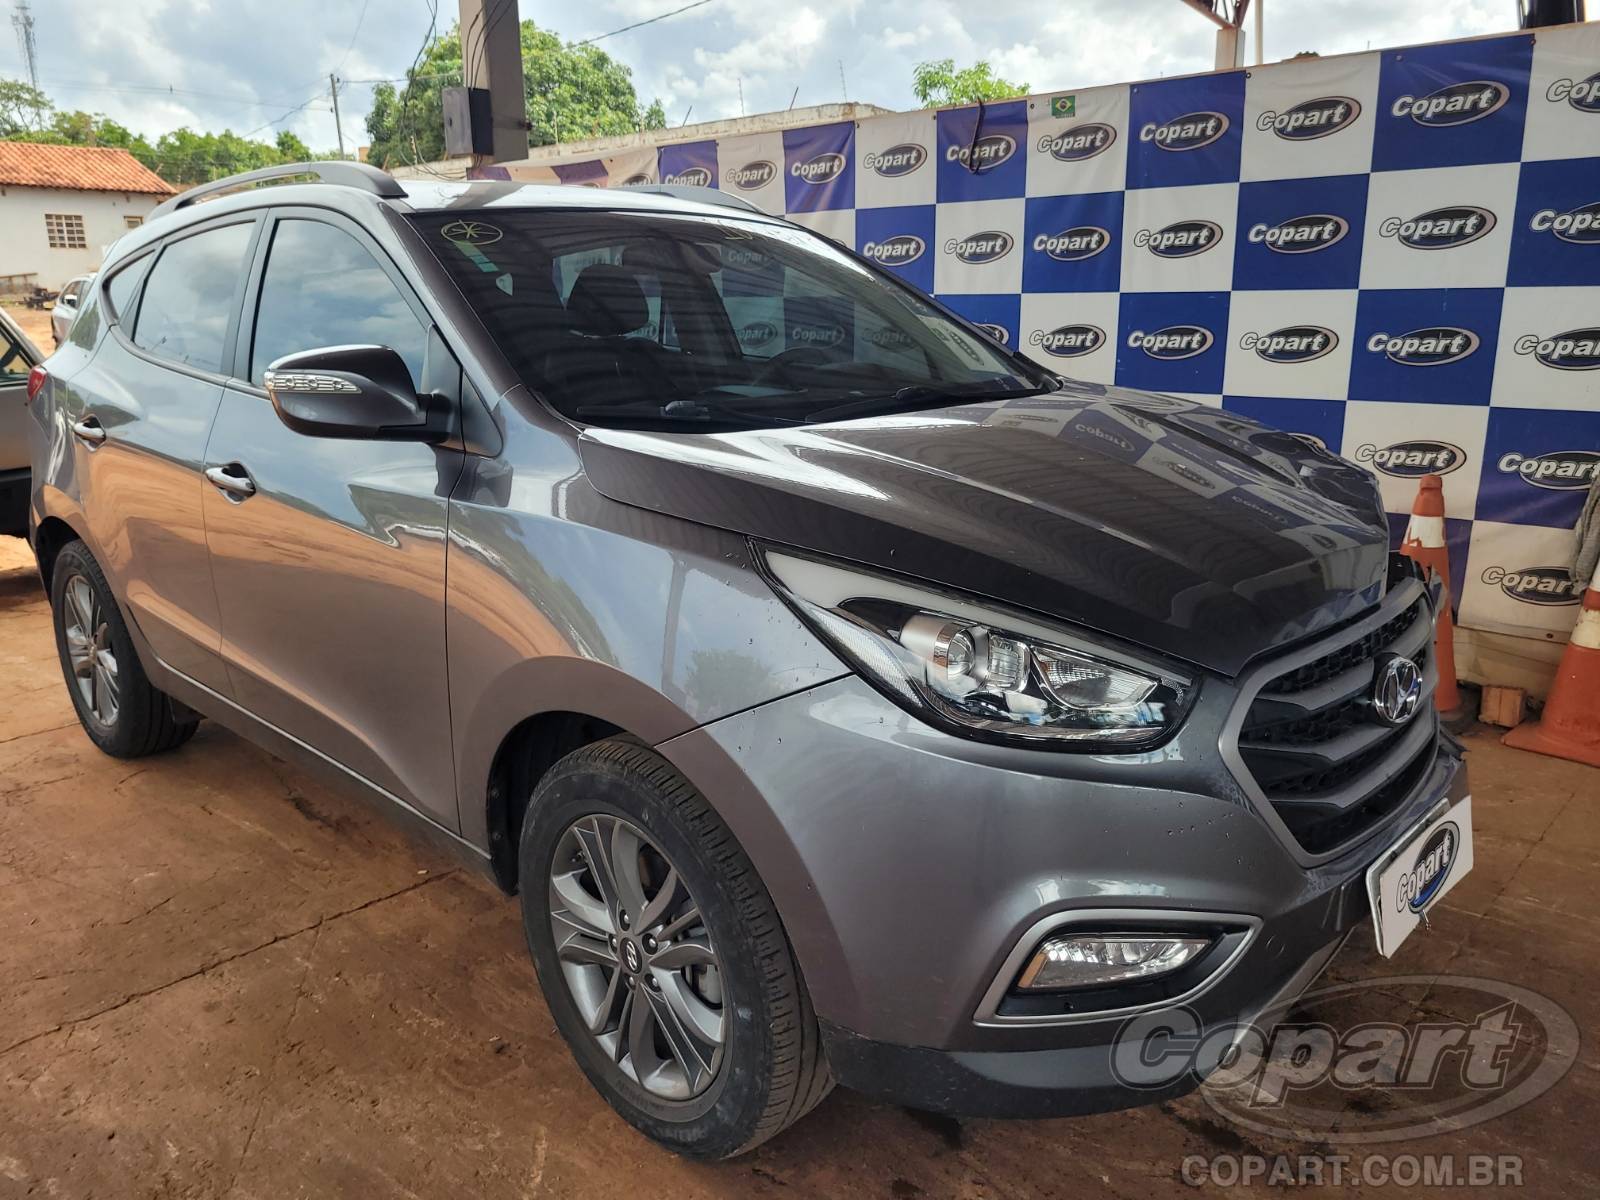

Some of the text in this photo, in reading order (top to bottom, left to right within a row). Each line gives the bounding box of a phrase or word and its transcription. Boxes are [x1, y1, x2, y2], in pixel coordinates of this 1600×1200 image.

[1392, 87, 1496, 120] Copart
[1546, 78, 1600, 105] Cop
[1139, 116, 1218, 144] Copart
[1256, 102, 1346, 134] Copart
[1037, 131, 1106, 155] Copart
[791, 157, 840, 177] Copart
[863, 151, 918, 172] Copart
[727, 165, 773, 184] Copart
[1249, 216, 1337, 246] Copart
[1379, 212, 1482, 243] Copart
[1529, 209, 1600, 236] Copa
[944, 233, 1005, 257] Copart
[1033, 229, 1102, 253] Copart
[1134, 223, 1211, 250] Copart
[863, 239, 917, 261] Copart
[1029, 329, 1096, 350] Copart
[1127, 329, 1203, 353] Copart
[1239, 331, 1329, 357] Copart
[1366, 332, 1466, 356] Copart
[1514, 335, 1600, 360] Copa
[1355, 444, 1451, 470] Copart
[1396, 829, 1453, 912] Copart
